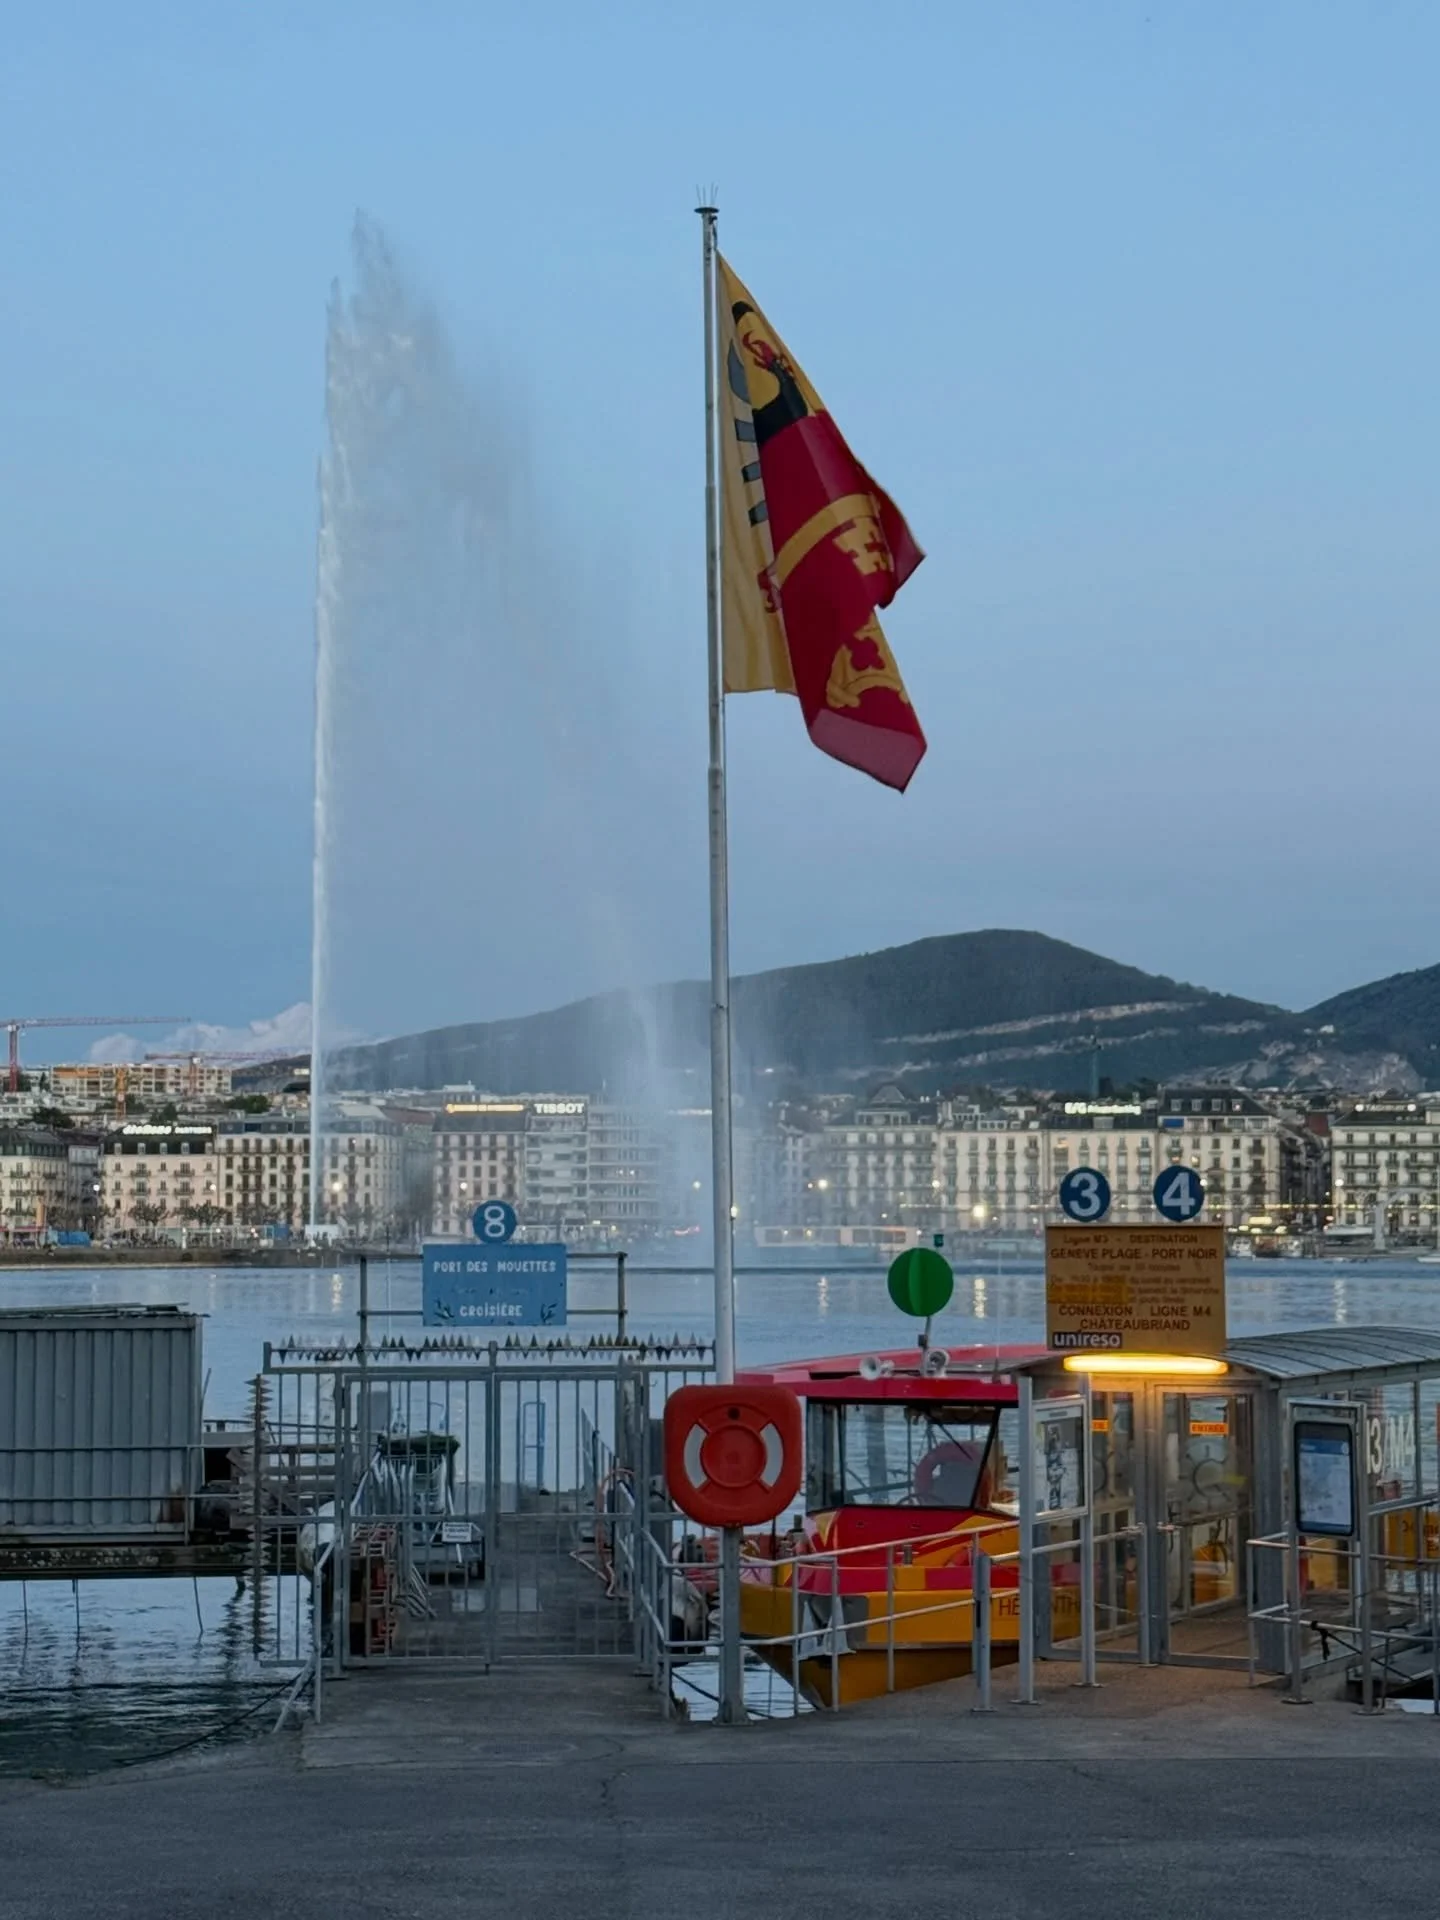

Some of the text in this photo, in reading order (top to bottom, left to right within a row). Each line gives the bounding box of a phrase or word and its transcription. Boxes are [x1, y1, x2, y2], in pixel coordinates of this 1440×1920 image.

[534, 1103, 585, 1113] TISSOT
[1069, 1172, 1101, 1217] 3
[1162, 1172, 1196, 1215] 4
[484, 1206, 505, 1237] 8
[1129, 1234, 1198, 1243] DESTINATION
[1101, 1248, 1141, 1259] PLAGE
[1152, 1248, 1185, 1259] PORT
[1187, 1248, 1217, 1259] NOIR
[433, 1261, 556, 1272] PORT DES MOUETTES
[1059, 1305, 1212, 1316] CONNEXION LIGNE M4
[1054, 1332, 1121, 1347] unireso
